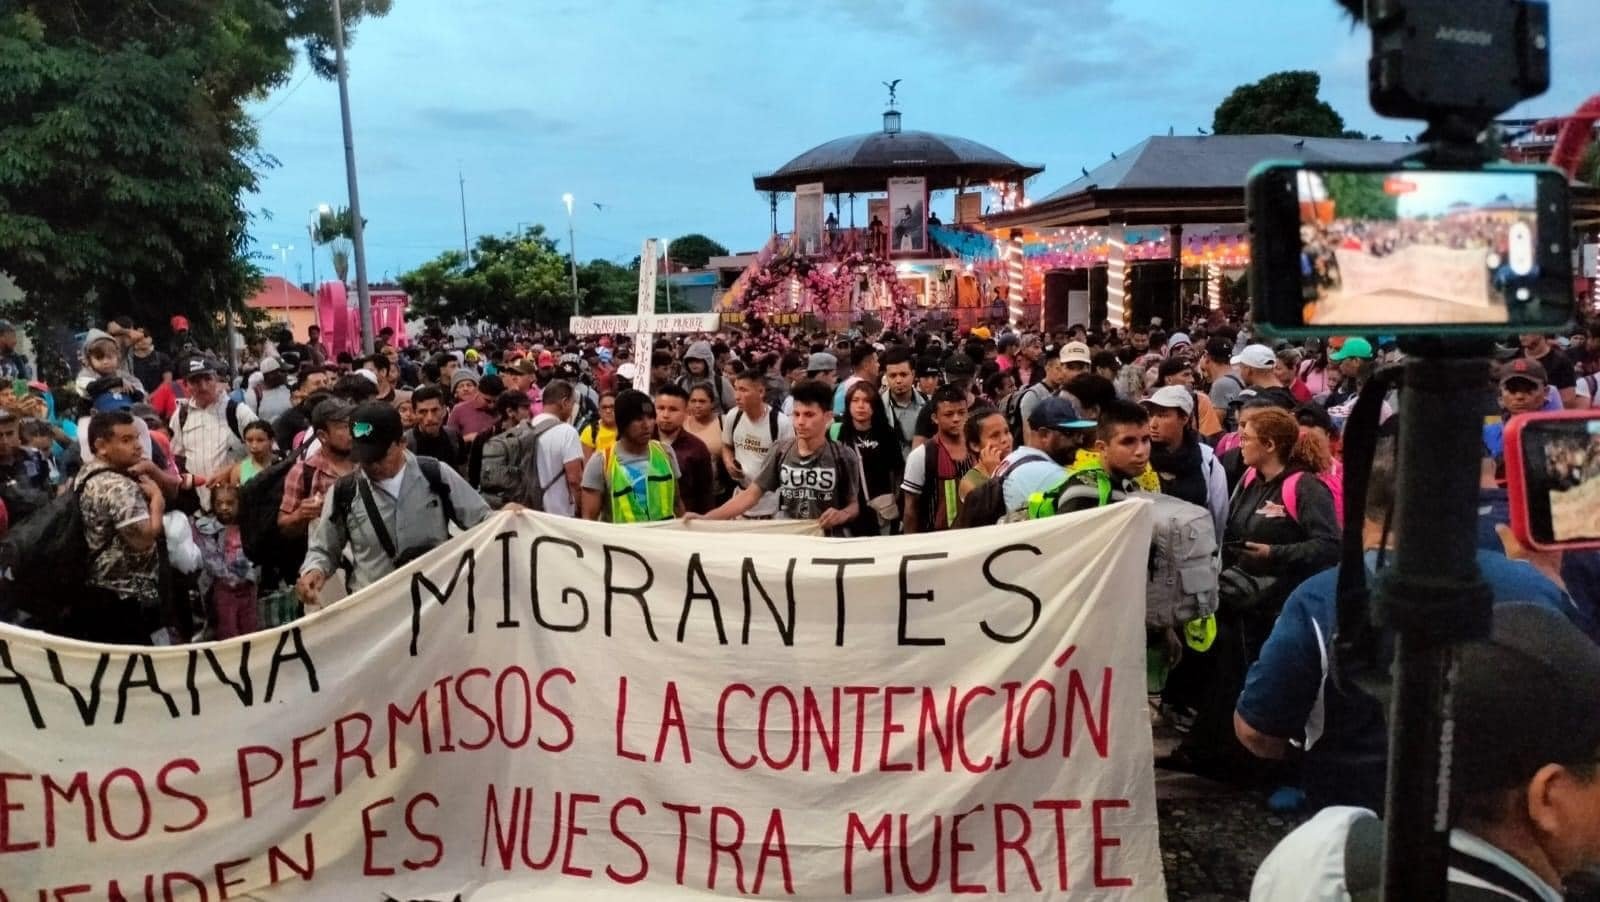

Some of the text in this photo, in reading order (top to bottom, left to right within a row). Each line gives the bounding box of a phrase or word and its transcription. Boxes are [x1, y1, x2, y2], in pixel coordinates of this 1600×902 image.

[780, 466, 833, 489] CUBS
[408, 530, 1043, 657] MIGRANTES
[0, 645, 1114, 854] EMOS PERMISOS LA CONTENCIÓN
[363, 792, 444, 877] ES
[481, 783, 796, 895] NUESTRA
[844, 799, 1133, 896] MUERTE
